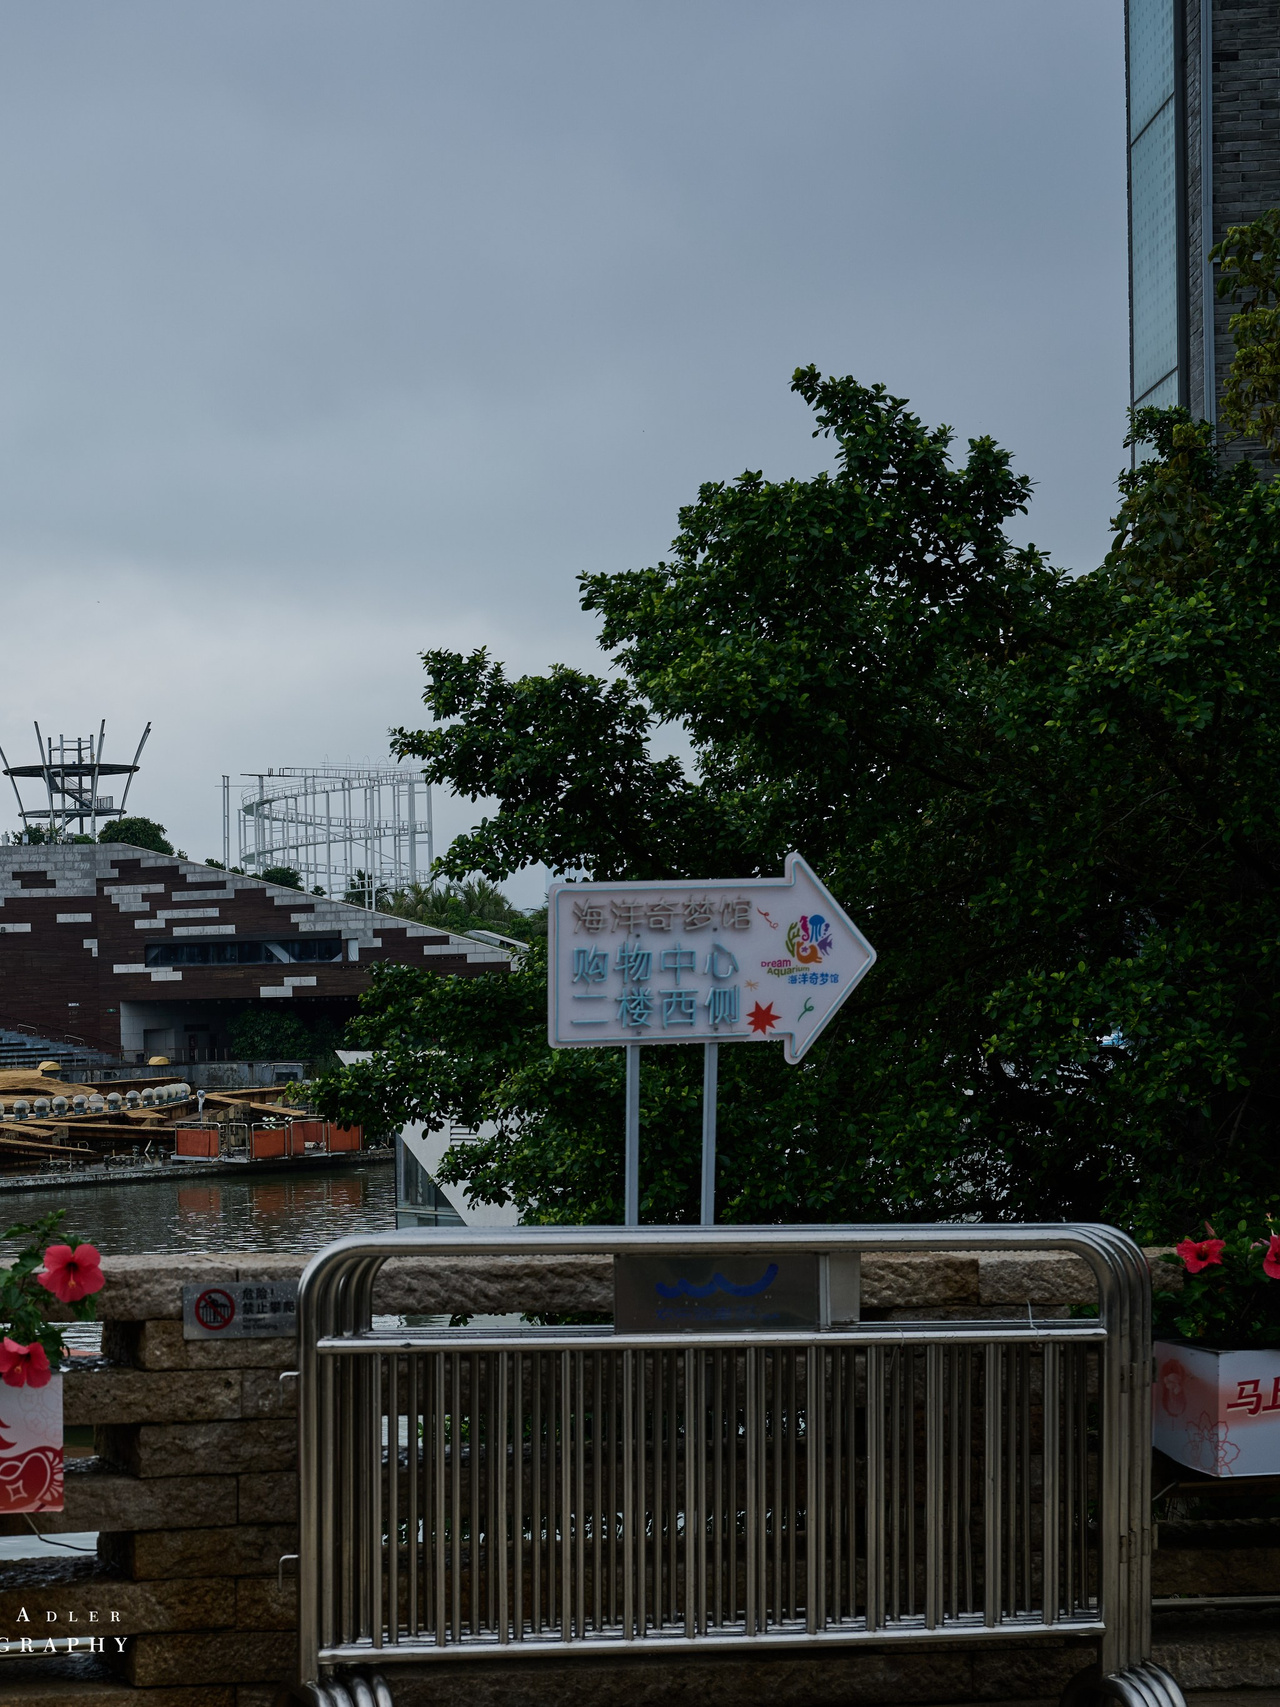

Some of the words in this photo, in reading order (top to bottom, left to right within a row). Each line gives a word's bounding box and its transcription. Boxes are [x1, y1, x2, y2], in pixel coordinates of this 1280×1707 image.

[573, 896, 752, 934] 海洋奇梦馆
[573, 942, 739, 984] 购物中心
[761, 959, 792, 968] Dream
[767, 965, 810, 978] Aquarium
[788, 972, 840, 985] 海洋奇梦馆
[570, 985, 740, 1029] 二楼西侧
